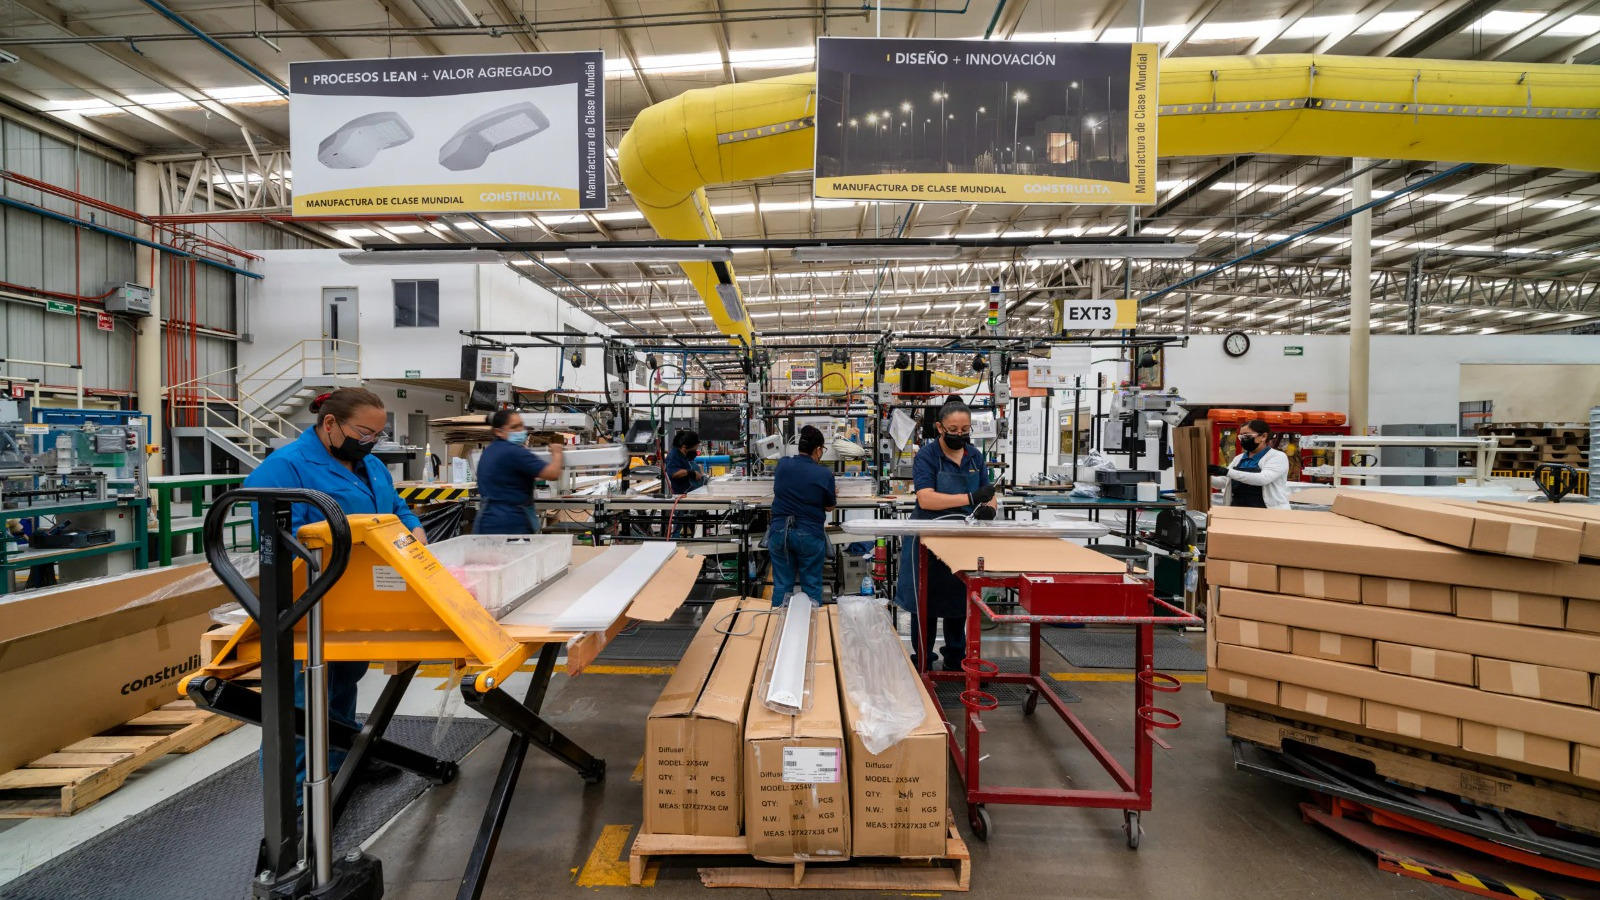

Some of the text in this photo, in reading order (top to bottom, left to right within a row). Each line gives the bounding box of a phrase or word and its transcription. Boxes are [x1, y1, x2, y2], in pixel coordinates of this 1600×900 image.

[895, 51, 949, 65] DISEÑO
[965, 52, 1056, 66] INNOVACIÓN
[313, 72, 379, 86] PROCESOS
[382, 71, 417, 82] LEAN
[432, 68, 474, 81] VALOR
[477, 66, 553, 79] AGREGADO
[1134, 53, 1148, 194] Manufactura de Clase Mundial
[584, 61, 596, 199] Manufactura de Clase Mundial
[832, 183, 1007, 194] MANUFACTURA DE CLASE MUNDIAL
[1023, 183, 1111, 194] CONSTRULITA
[306, 196, 464, 208] MANUFACTURA DE CLASE MUNDIAL
[479, 191, 561, 202] CONSTRULITA
[1069, 306, 1111, 320] EXT3
[865, 761, 893, 769] Diffuser
[865, 775, 894, 783] MODEL:
[760, 784, 790, 792] MODEL:
[865, 790, 882, 798] QTY:
[921, 790, 937, 798] PCS
[818, 796, 834, 804] PCS
[818, 812, 835, 820] KGS
[827, 826, 839, 834] CM
